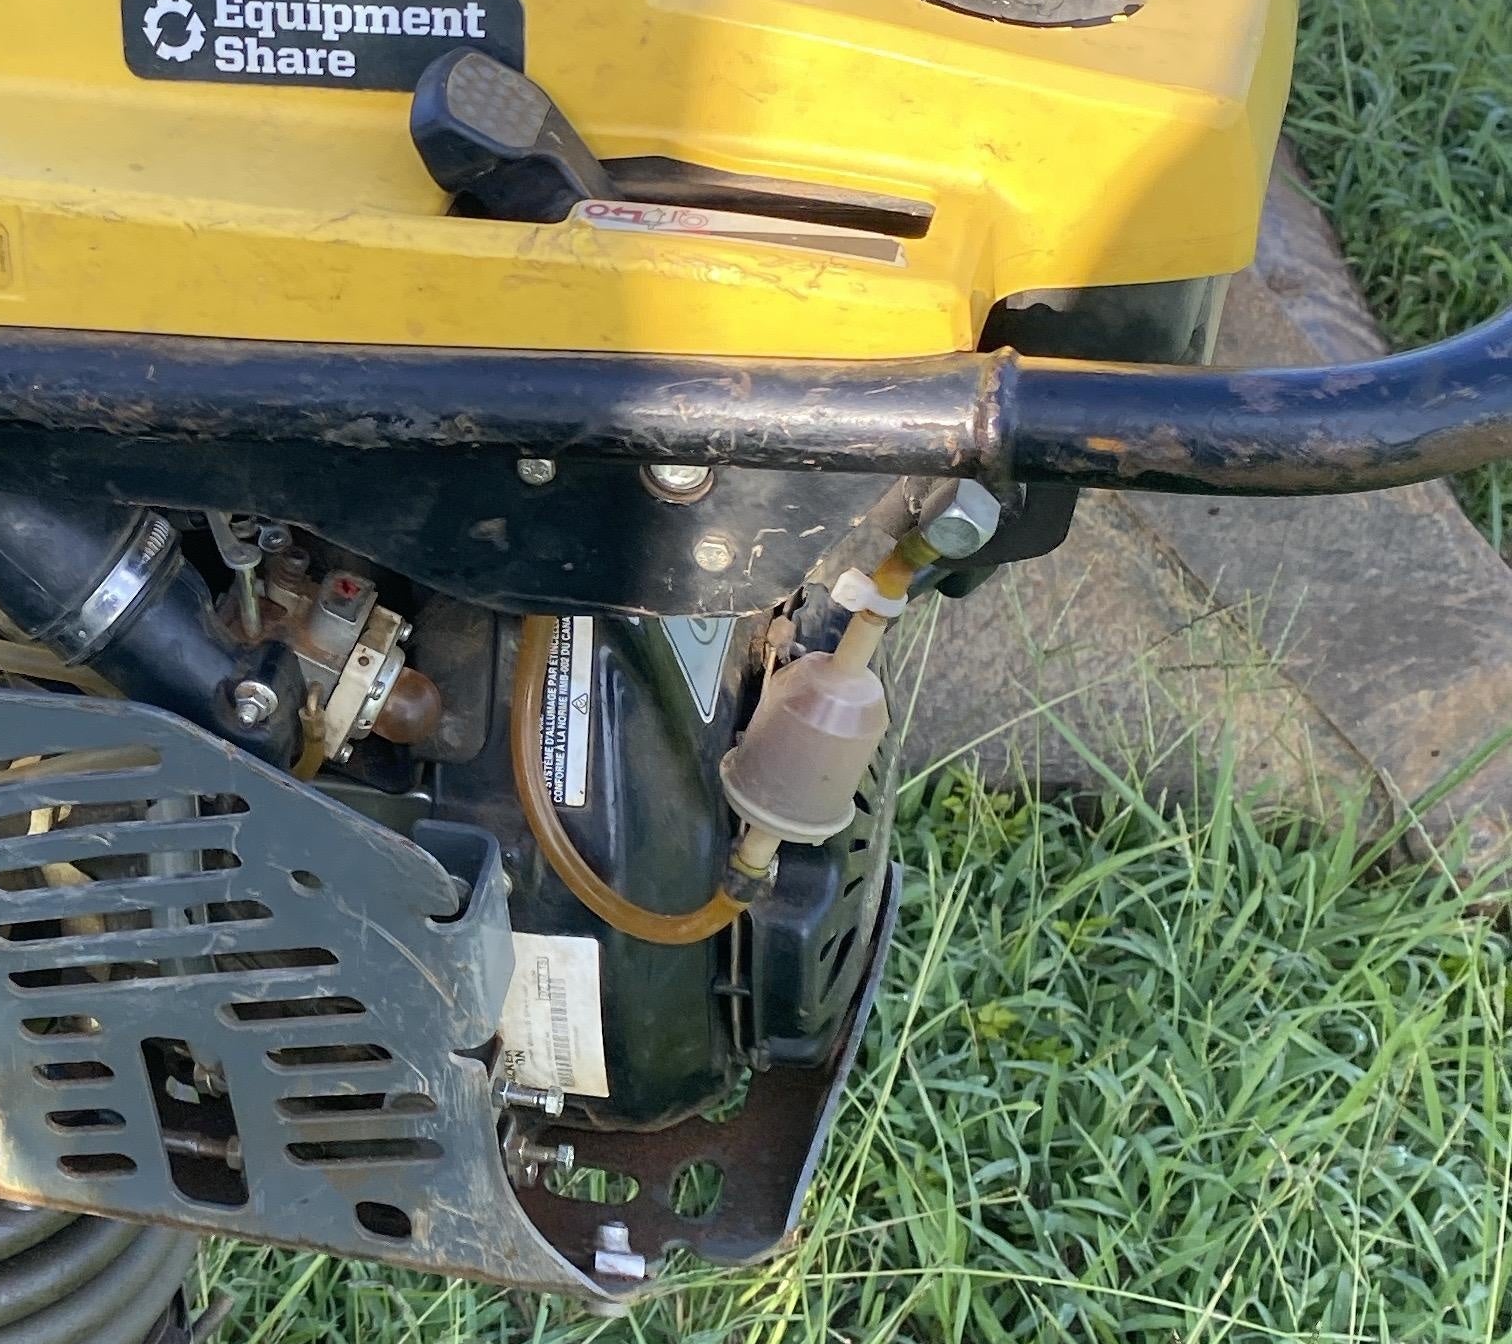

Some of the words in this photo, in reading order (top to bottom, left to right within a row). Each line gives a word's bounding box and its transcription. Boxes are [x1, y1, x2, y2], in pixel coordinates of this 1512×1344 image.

[213, 35, 357, 78] Share
[561, 640, 571, 656] DU
[548, 667, 558, 686] PAR
[557, 695, 568, 727] NORME
[557, 729, 566, 743] LA
[553, 751, 565, 803] CONFORME
